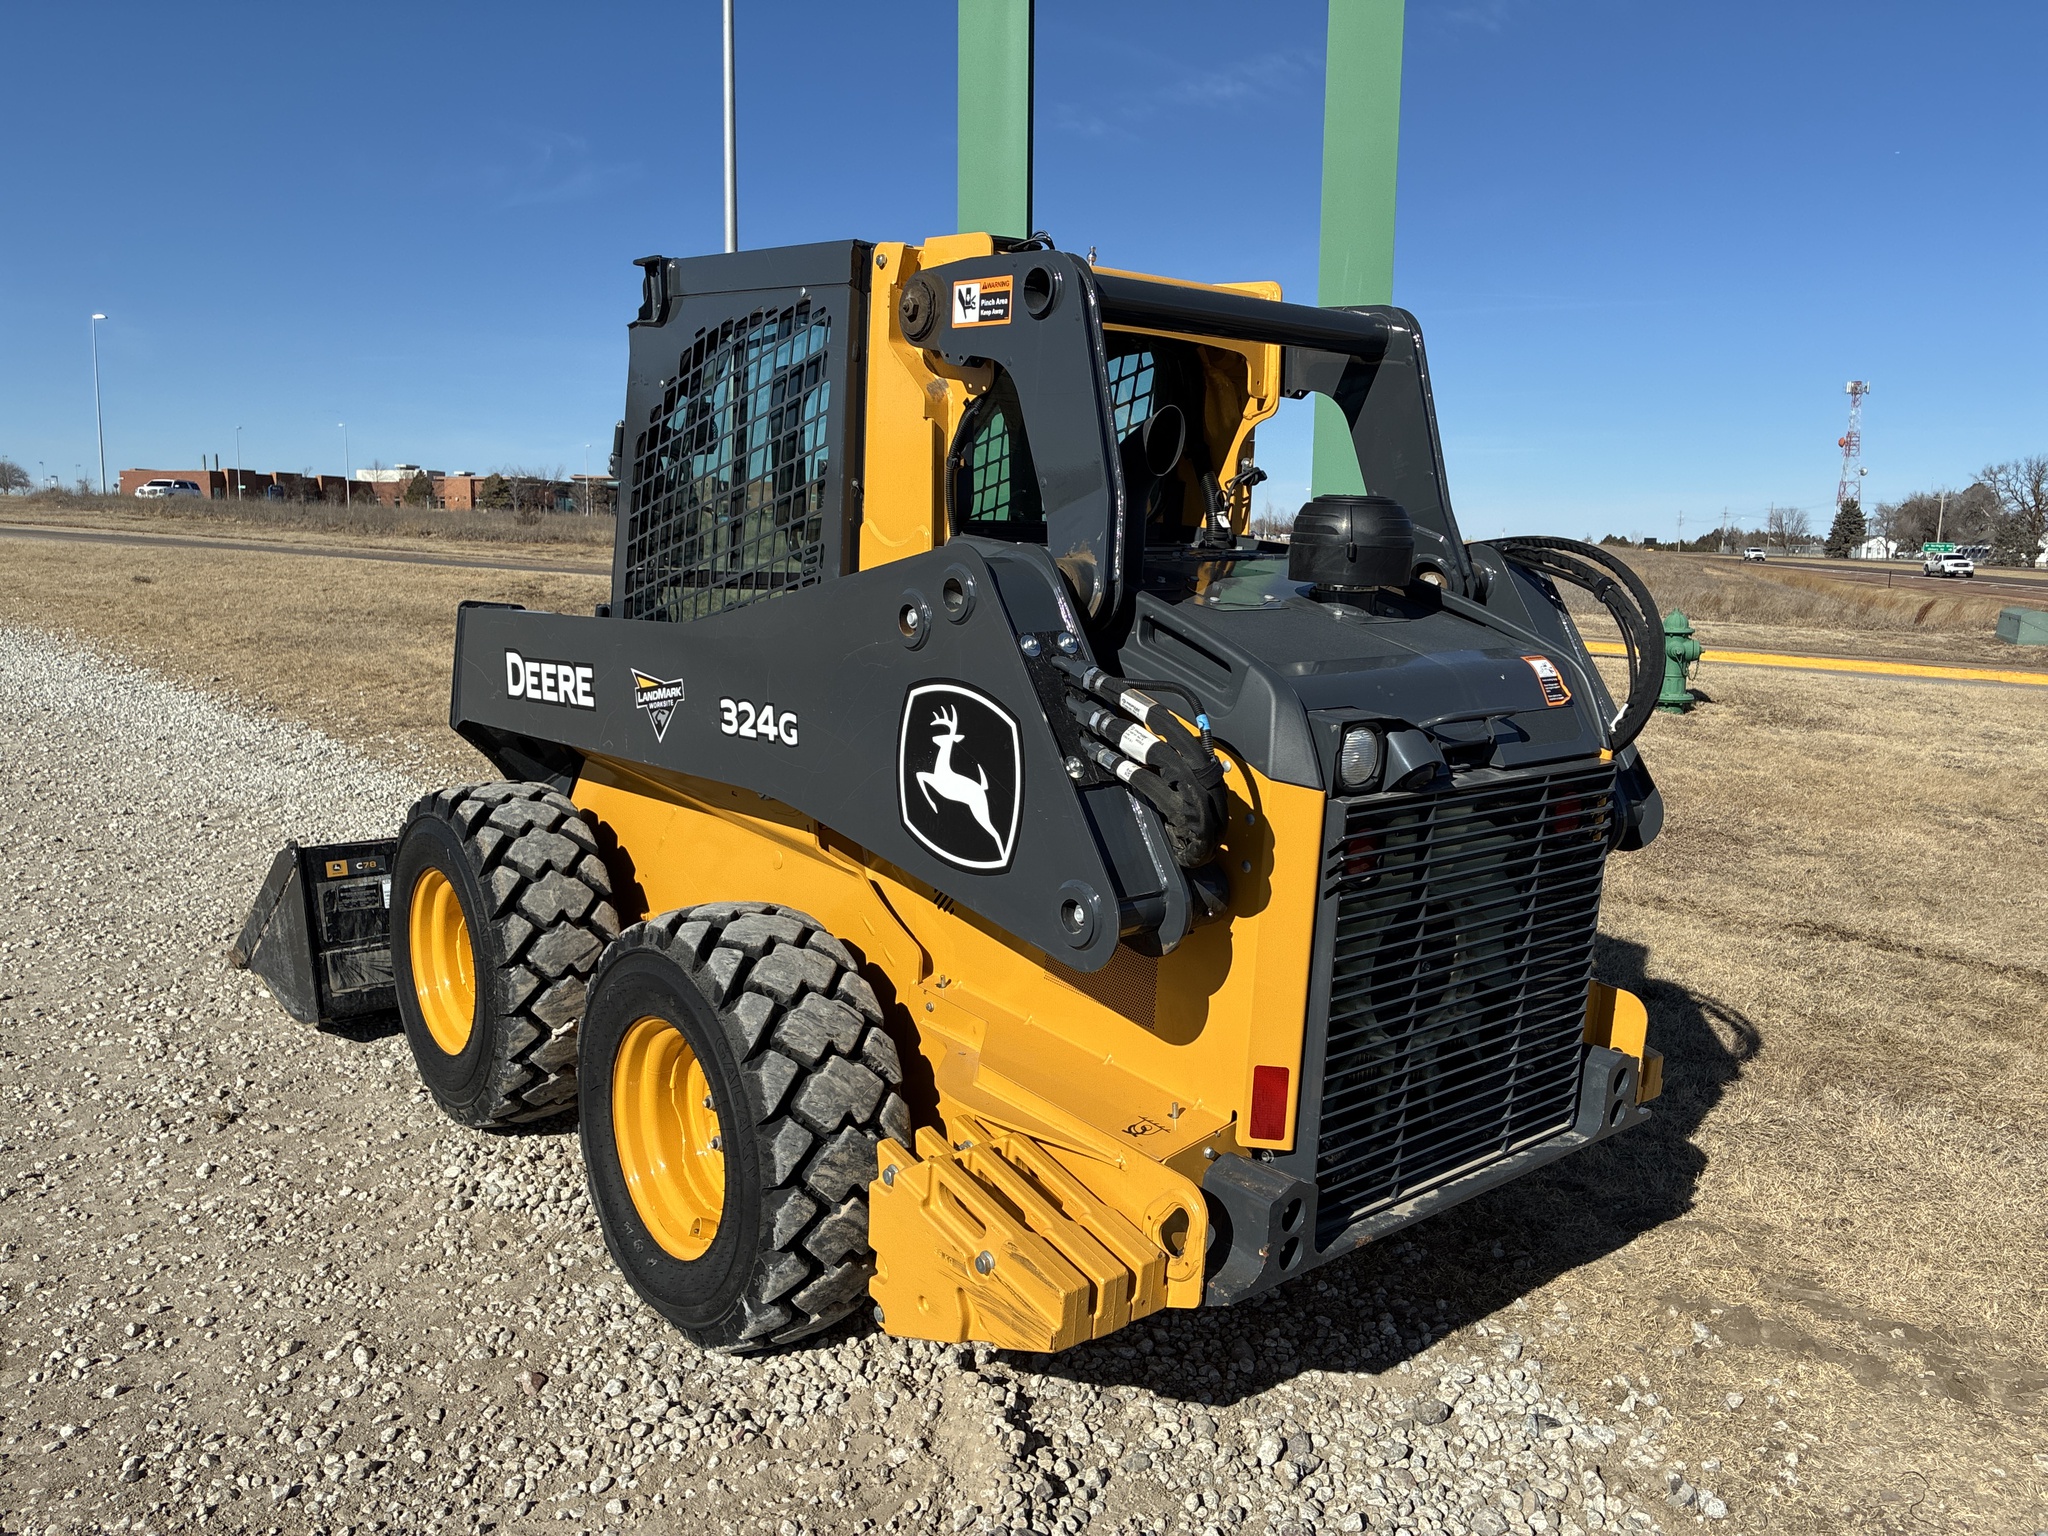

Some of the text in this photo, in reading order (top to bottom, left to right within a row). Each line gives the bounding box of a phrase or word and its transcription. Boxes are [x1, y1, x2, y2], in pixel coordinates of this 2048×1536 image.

[987, 281, 1010, 289] WARNING
[980, 297, 1008, 306] Pinch Area
[992, 308, 1004, 316] Away
[505, 651, 595, 708] DEERE
[637, 686, 682, 703] LANDMARK
[648, 699, 674, 710] WORKSITE
[719, 698, 799, 746] 324G
[355, 860, 377, 870] C78
